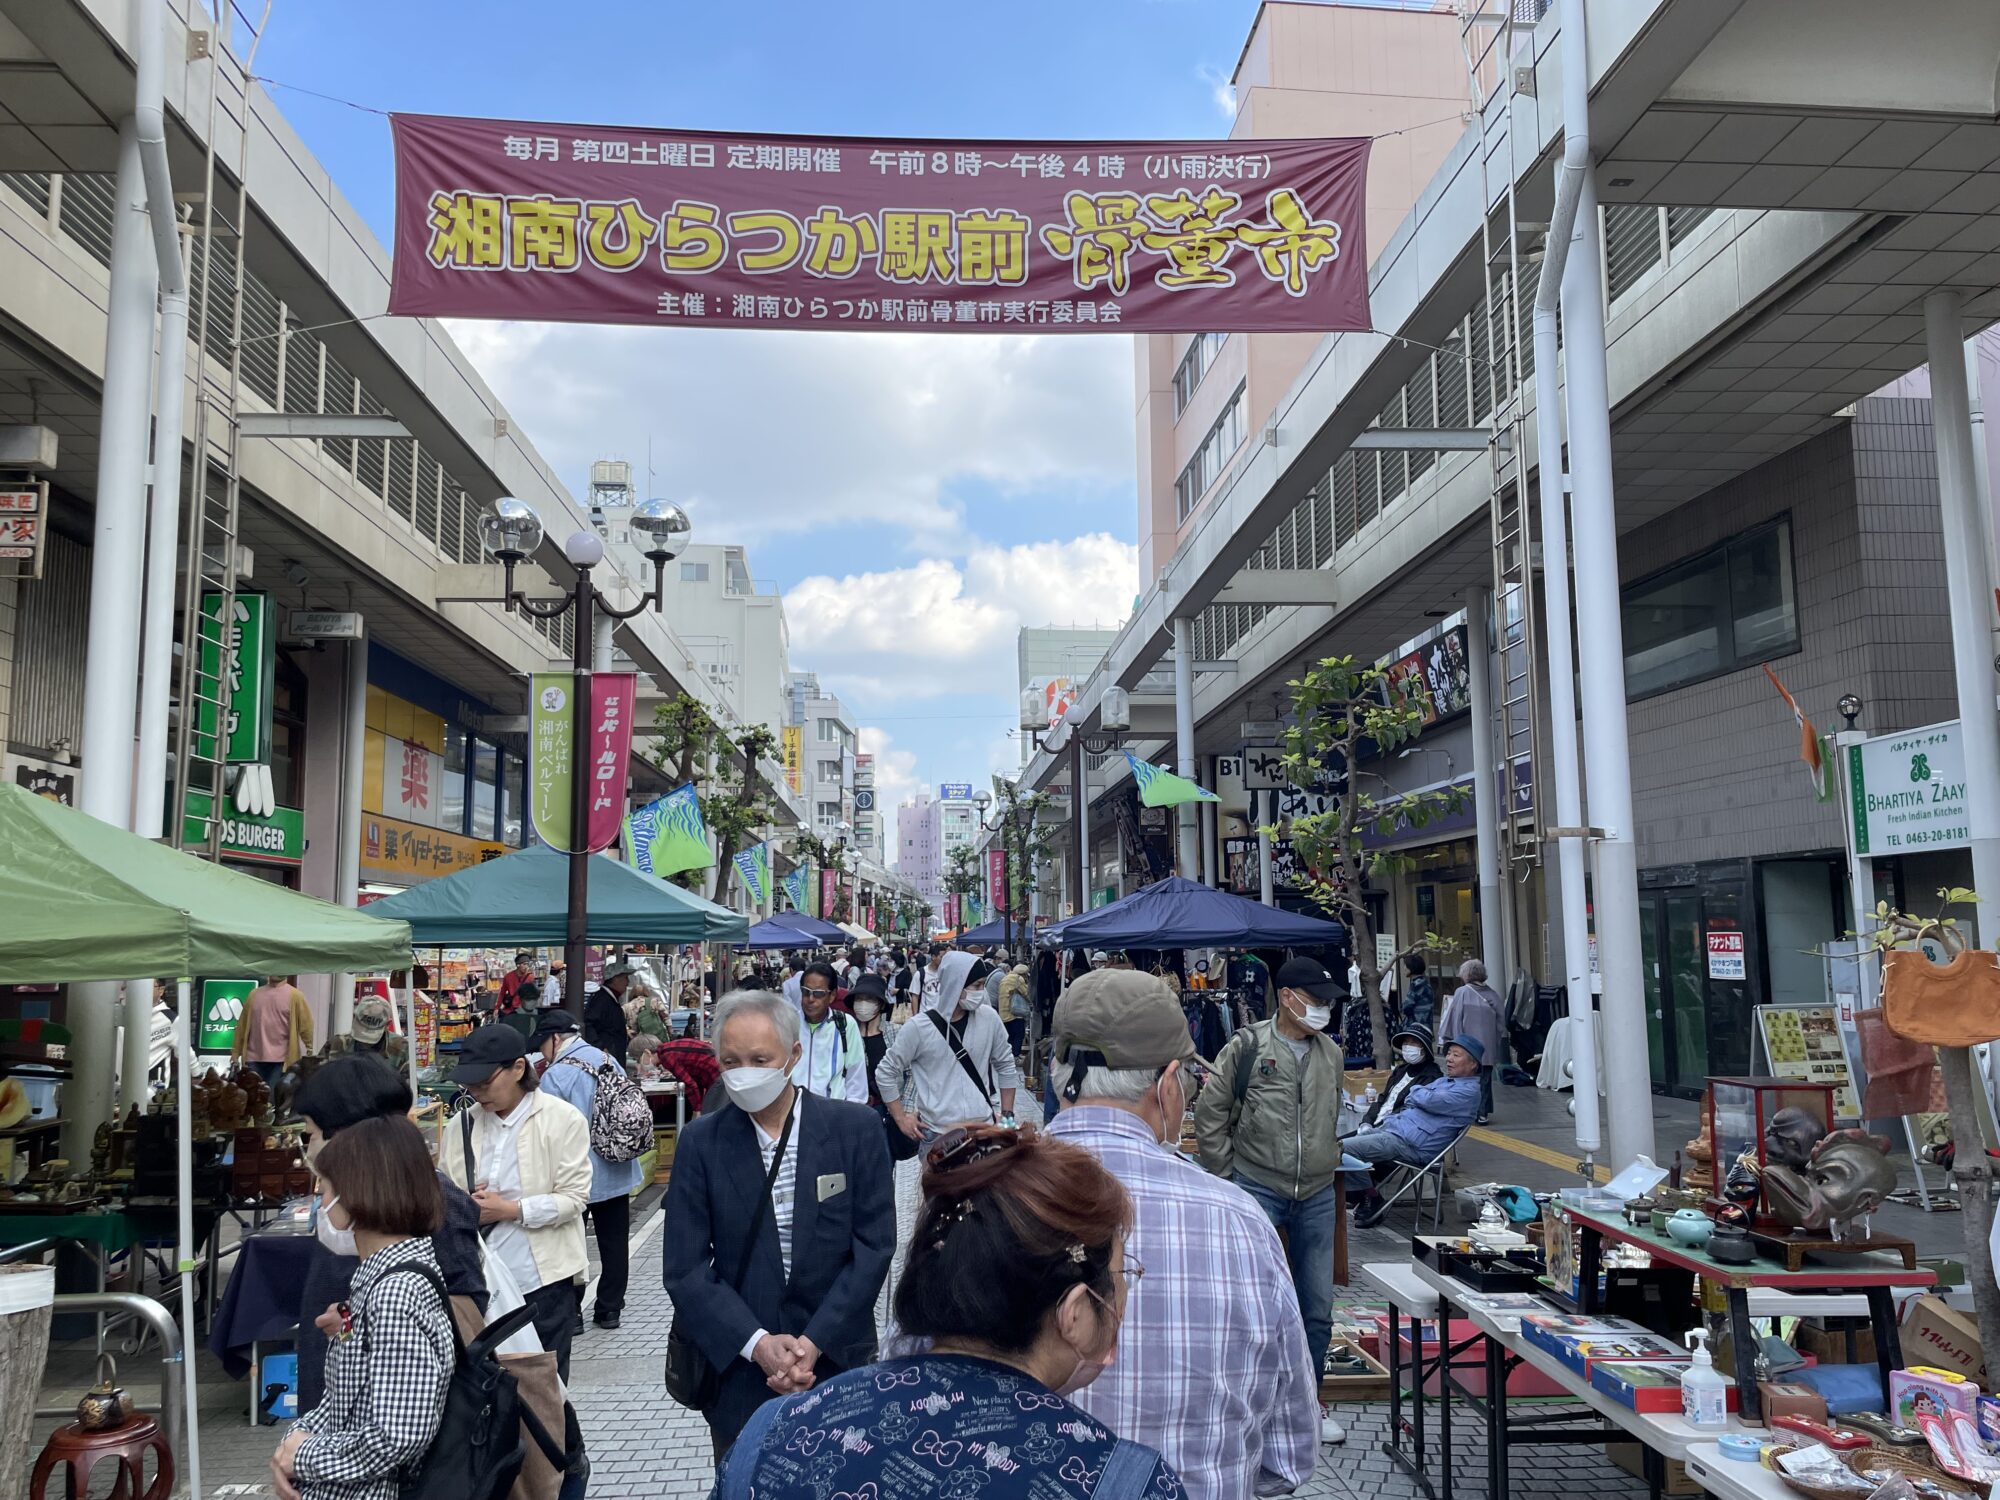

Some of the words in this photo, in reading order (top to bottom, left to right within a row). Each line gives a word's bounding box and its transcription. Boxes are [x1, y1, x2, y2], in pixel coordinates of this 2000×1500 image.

[503, 136, 560, 162] 毎月
[572, 140, 715, 168] 第四土曜日
[727, 144, 841, 173] 定期開催
[1143, 154, 1273, 179] (小雨決行)
[427, 190, 1031, 286] 湘南ひらつか駅前
[1039, 184, 1342, 297] 骨董市
[555, 720, 568, 775] がんばれ
[401, 736, 429, 809] 薬
[538, 720, 554, 822] 湘南ベルマーレ
[1219, 759, 1241, 776] B1
[1868, 790, 1924, 812] BHARTIYA
[1888, 814, 1907, 824] Fresh
[1909, 809, 1932, 822] Indian
[1934, 806, 1963, 818] Kitchen
[237, 822, 285, 851] BURGER
[385, 828, 397, 860] 薬
[1887, 835, 1902, 846] TEL
[1906, 827, 1968, 844] 0463-20-8181
[204, 1024, 238, 1032] モスバー
[822, 1385, 834, 1397] MY
[950, 1391, 965, 1403] MY
[1896, 1387, 1908, 1399] Hop
[1906, 1383, 1924, 1392] along
[1925, 1386, 1939, 1397] with
[910, 1394, 948, 1412] MELODY
[972, 1395, 989, 1406] New
[990, 1396, 1011, 1405] places
[829, 1428, 844, 1441] MY
[1095, 1427, 1107, 1441] MY
[967, 1441, 986, 1457] MY
